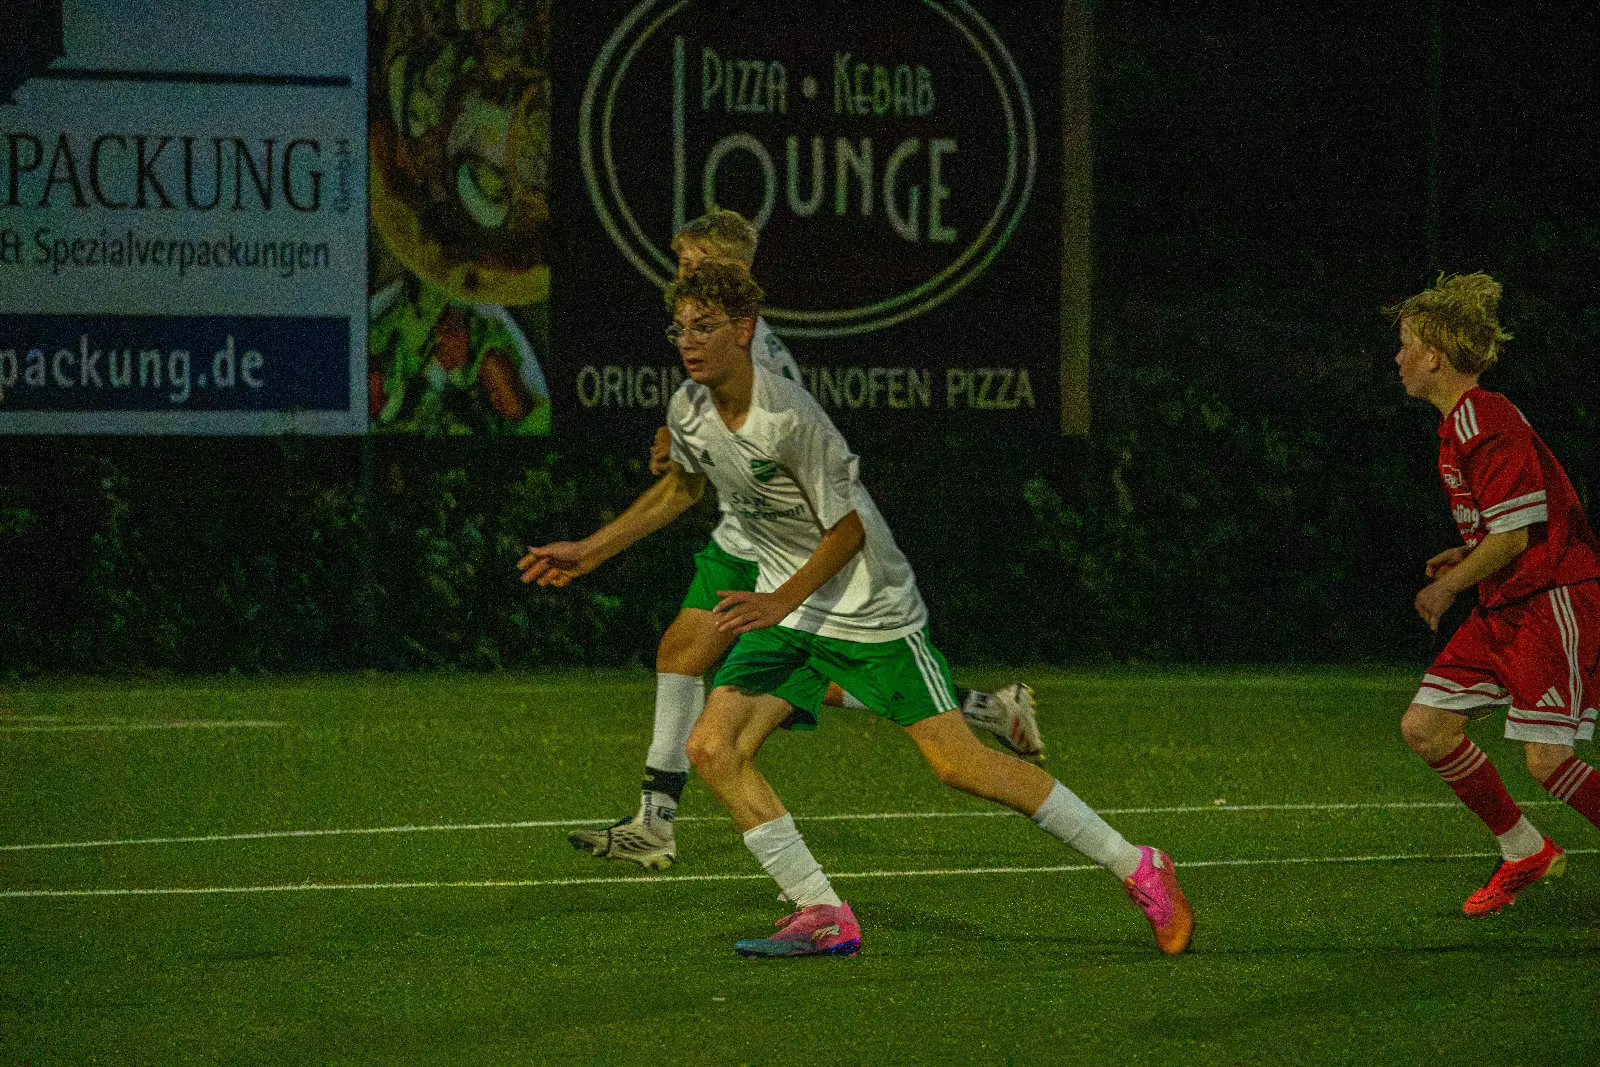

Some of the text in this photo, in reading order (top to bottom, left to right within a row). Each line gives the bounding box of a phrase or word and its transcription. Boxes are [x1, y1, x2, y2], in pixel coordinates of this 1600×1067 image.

[701, 46, 936, 116] PIZZA KEBAB
[7, 132, 322, 213] PACKUNG
[34, 227, 330, 278] Spezialverpackungen
[0, 333, 265, 402] packung.de
[946, 368, 1036, 410] PIZZA
